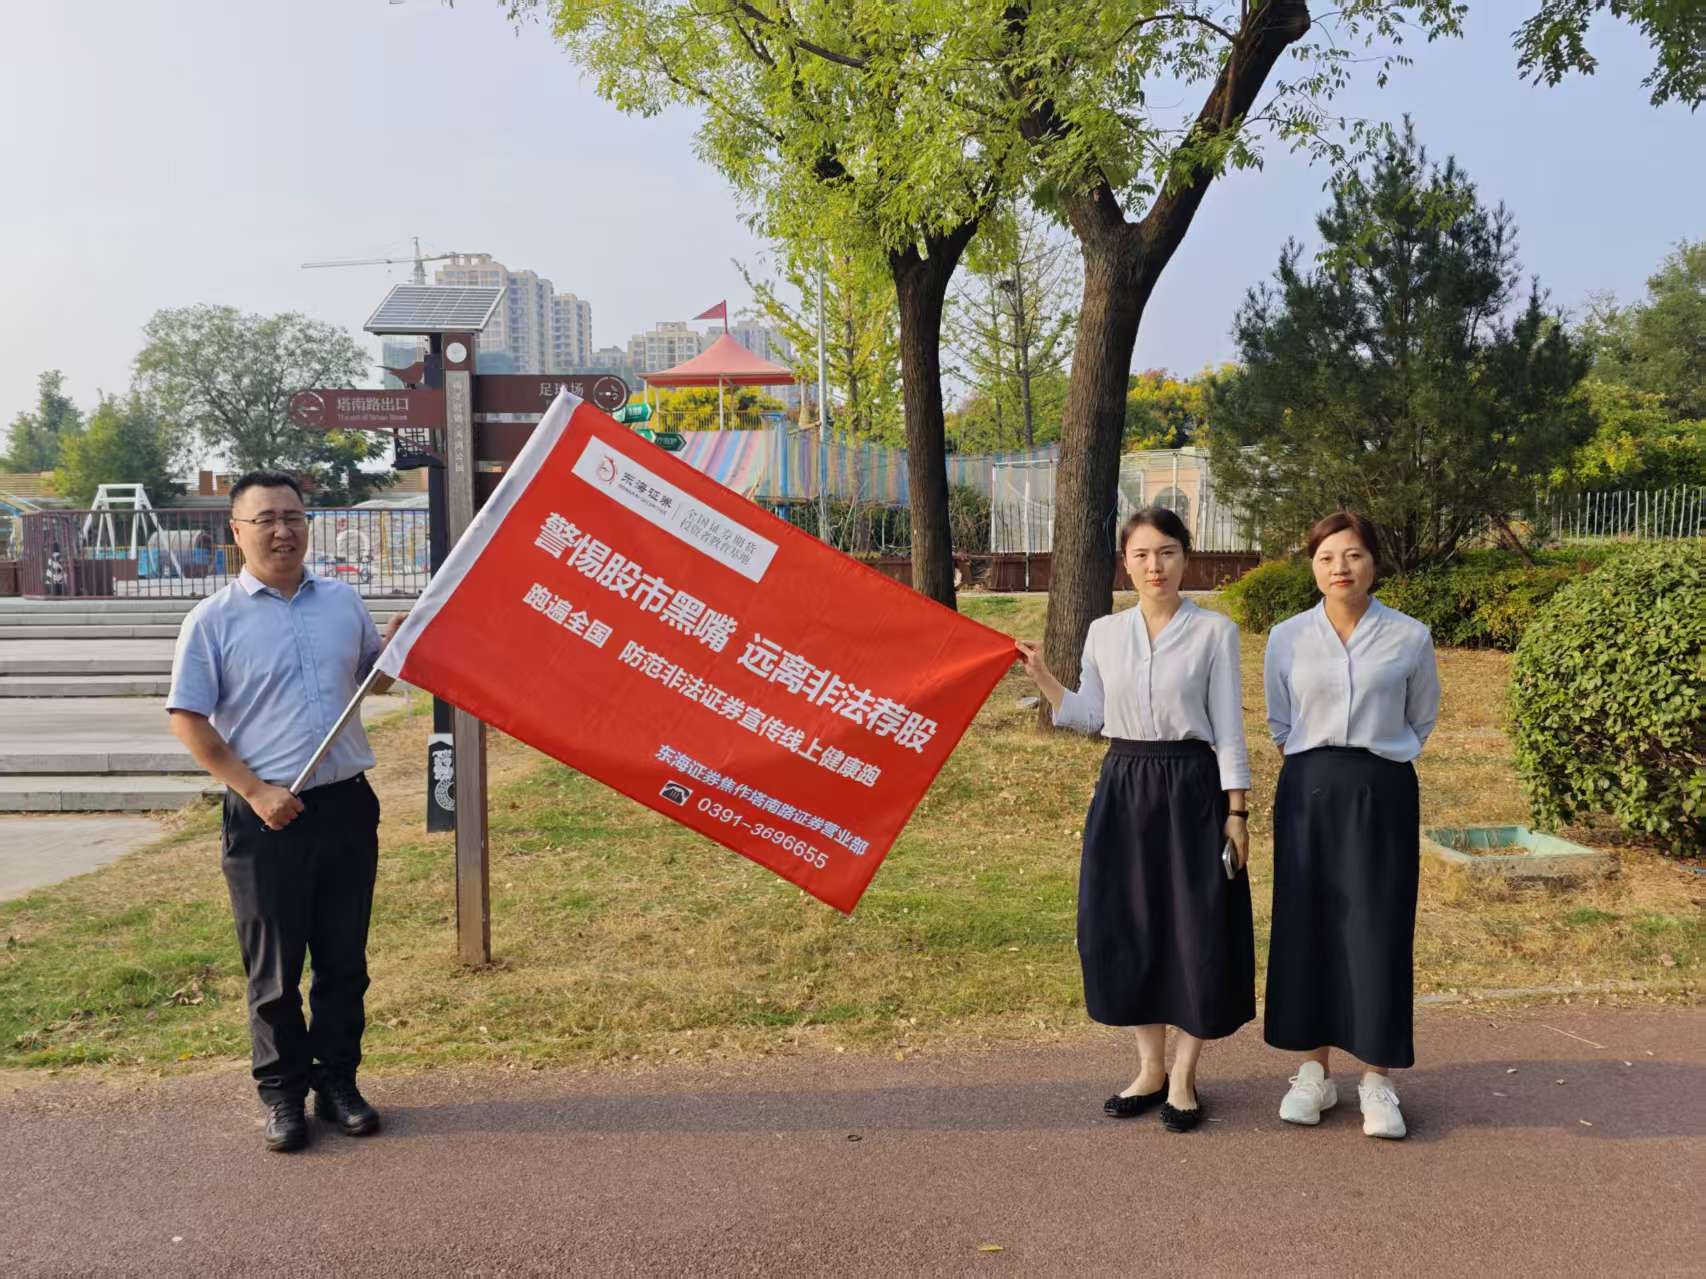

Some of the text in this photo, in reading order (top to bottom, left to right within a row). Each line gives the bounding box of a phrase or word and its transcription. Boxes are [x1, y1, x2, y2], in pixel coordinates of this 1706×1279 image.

[522, 582, 881, 788] 跑遍全国 防范非法证券宣传线上健康跑
[534, 511, 938, 754] 警惕股市黑嘴 远离非法荐股
[655, 744, 870, 857] 东海证券焦作塔南路证券营业部
[697, 797, 829, 869] 0391-3696655
